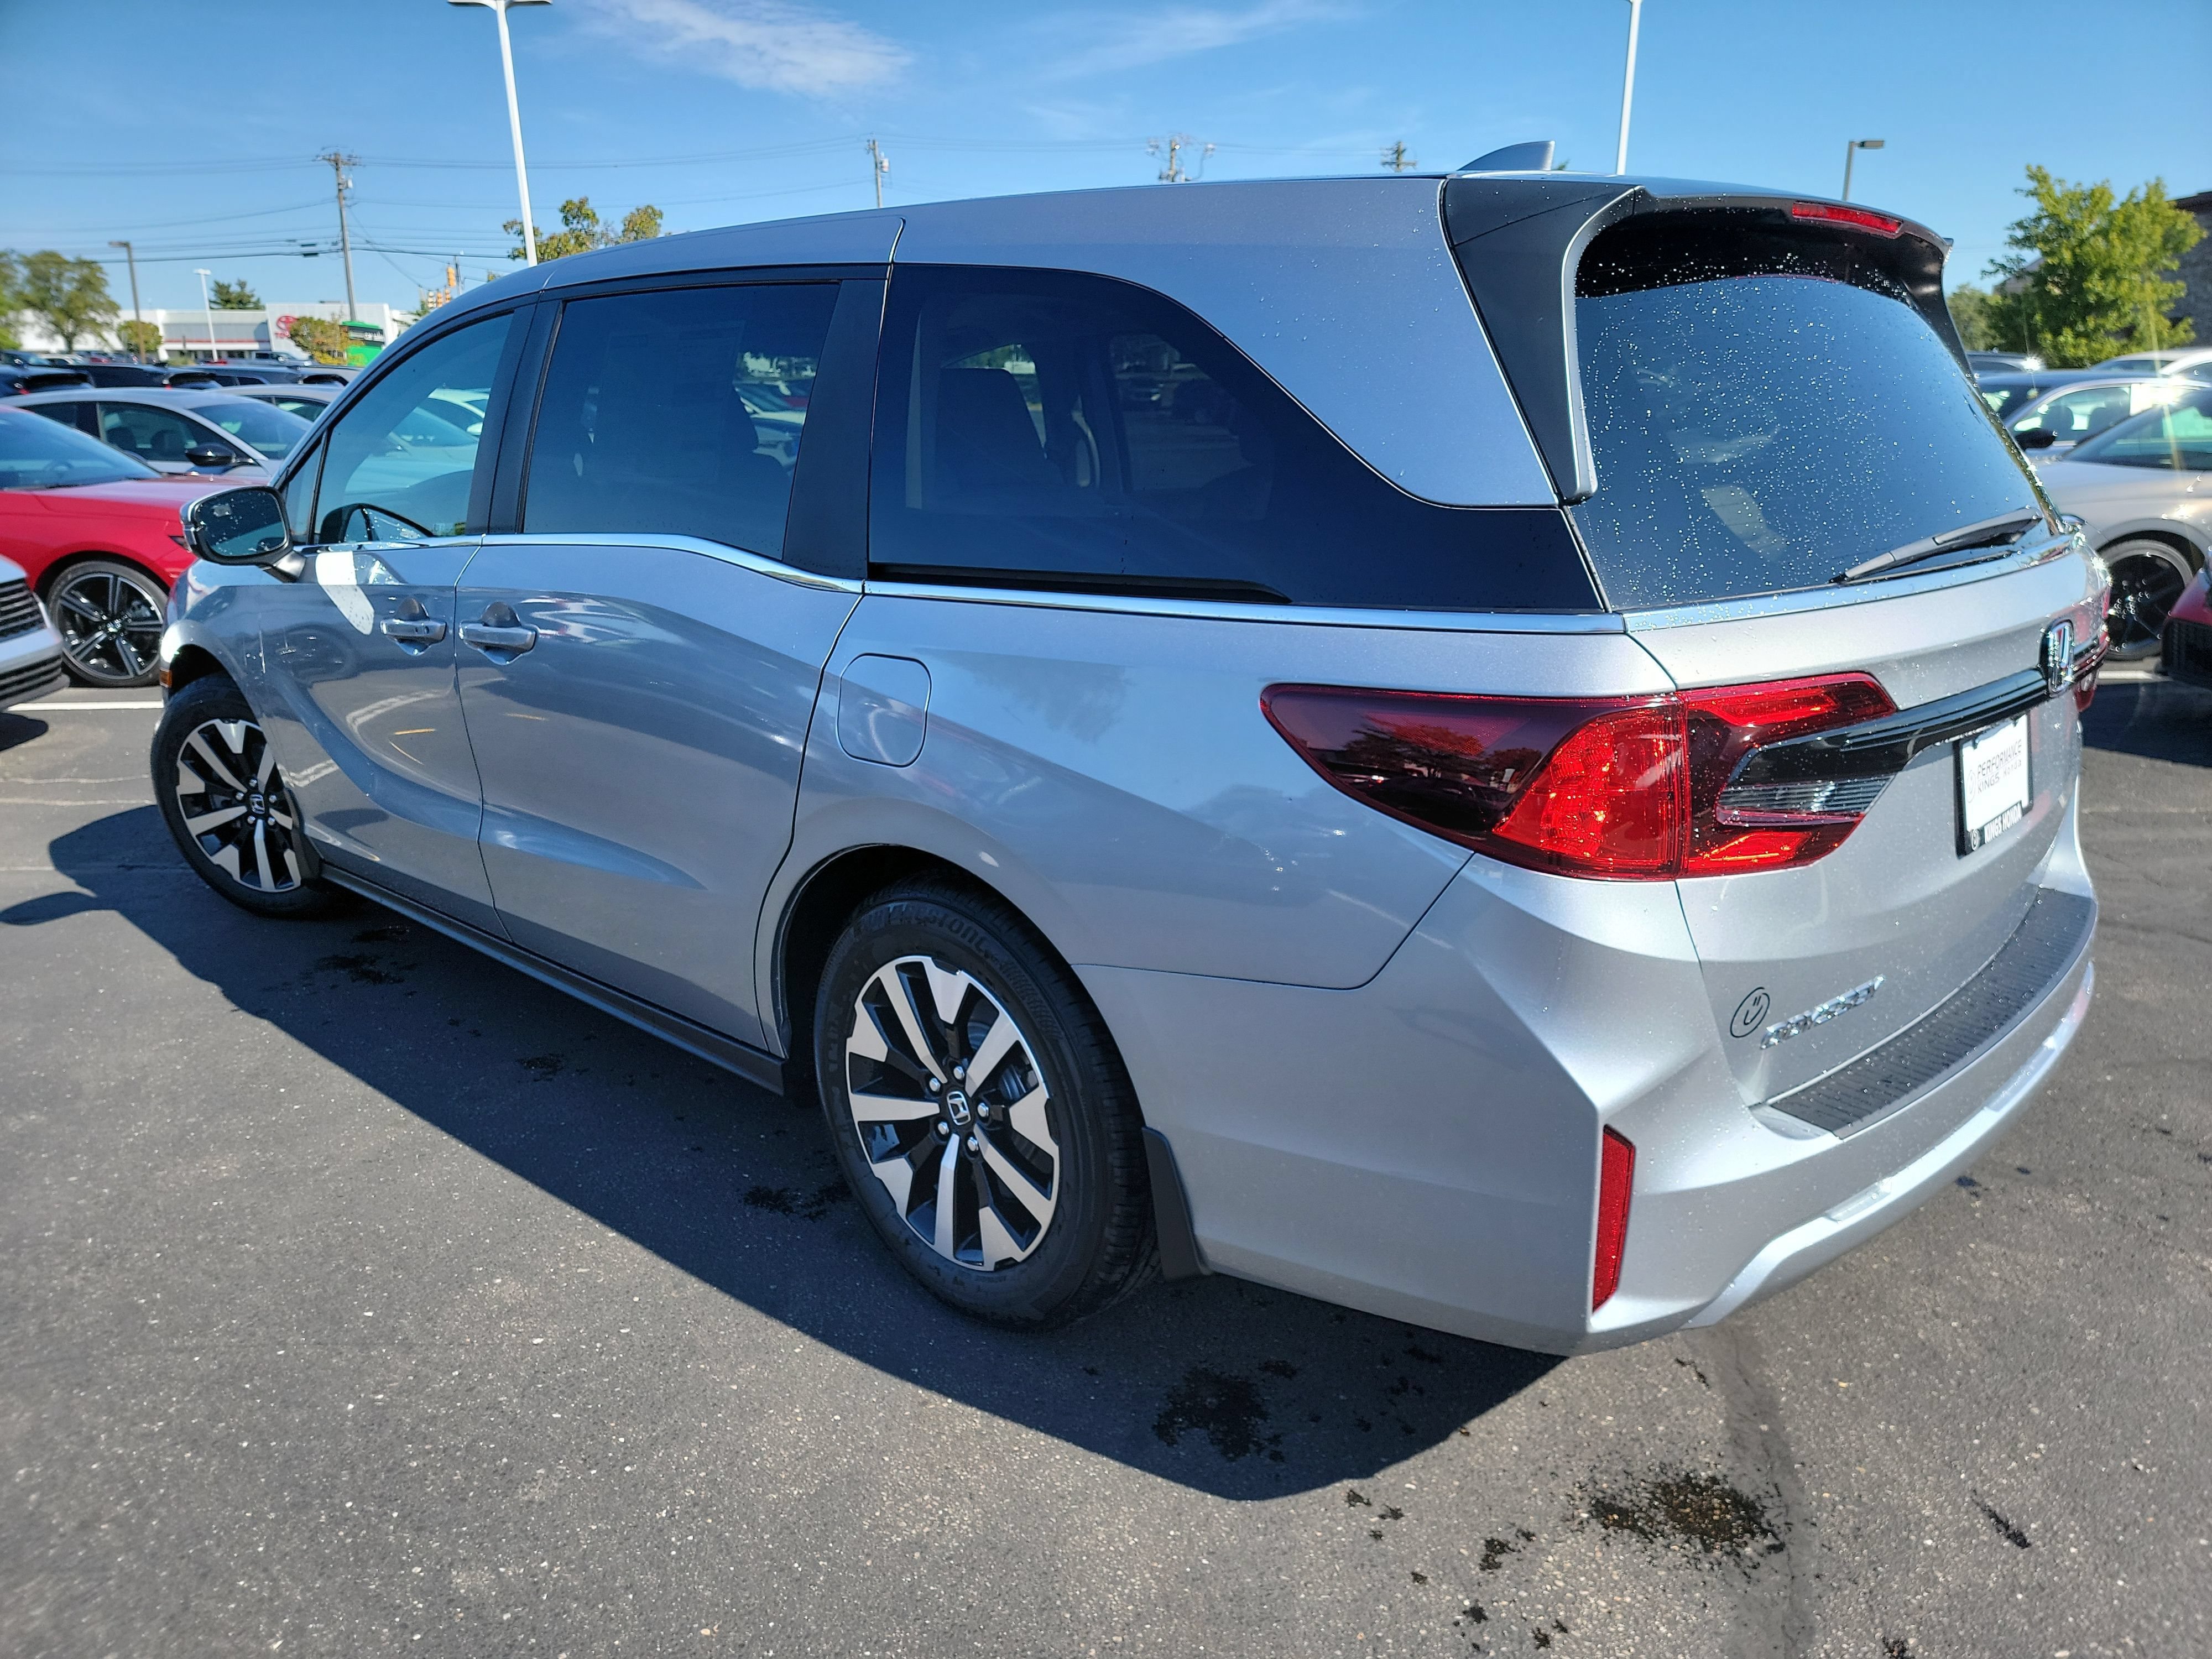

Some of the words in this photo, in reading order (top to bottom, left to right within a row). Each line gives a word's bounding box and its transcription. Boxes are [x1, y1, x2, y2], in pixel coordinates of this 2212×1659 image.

[1978, 739, 2022, 777] PERFORMANCE
[1978, 773, 2000, 794] KINGS
[2003, 759, 2022, 778] Honda
[1984, 815, 2003, 845] KINGS
[2002, 802, 2022, 832] HONDA
